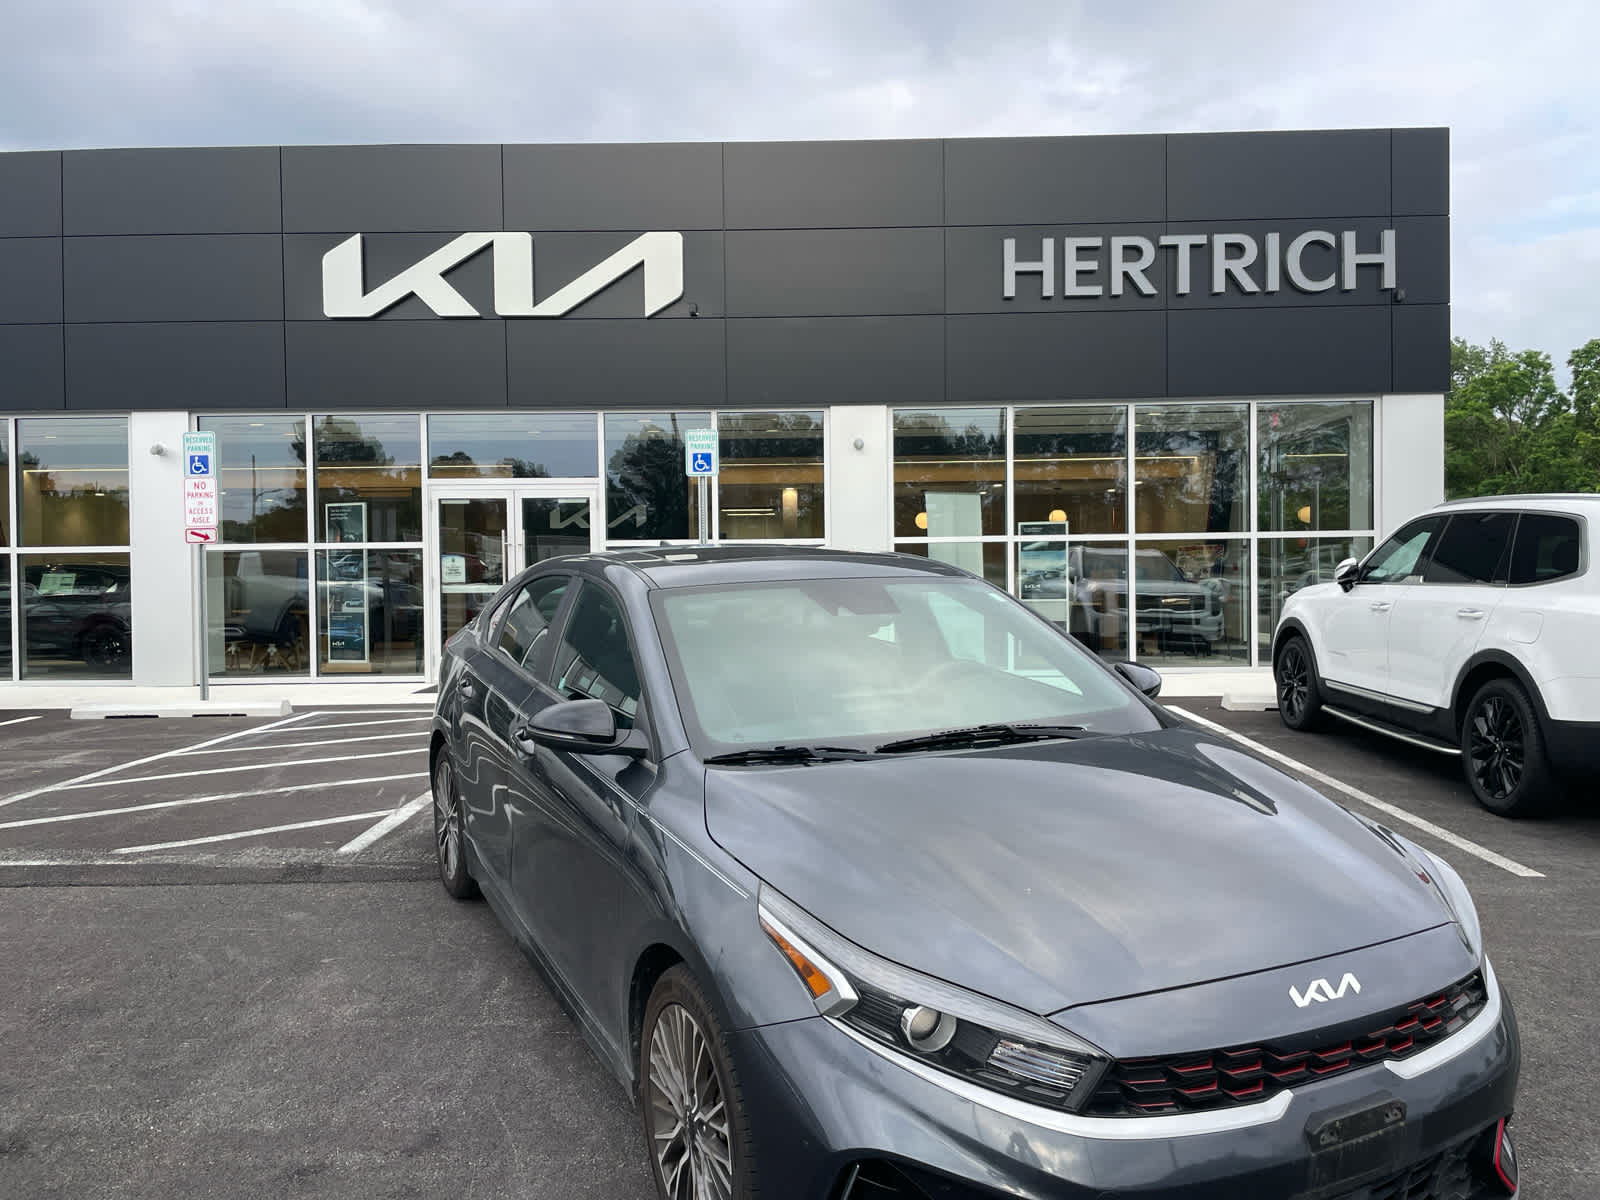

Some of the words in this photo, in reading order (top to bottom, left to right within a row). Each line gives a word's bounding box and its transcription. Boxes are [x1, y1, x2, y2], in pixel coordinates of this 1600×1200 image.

[322, 231, 684, 318] KIA
[1002, 229, 1396, 298] HERTRICH
[186, 491, 214, 499] PARKING
[193, 481, 207, 490] NO
[188, 507, 213, 515] ACCESS
[1288, 972, 1361, 1009] KIA
